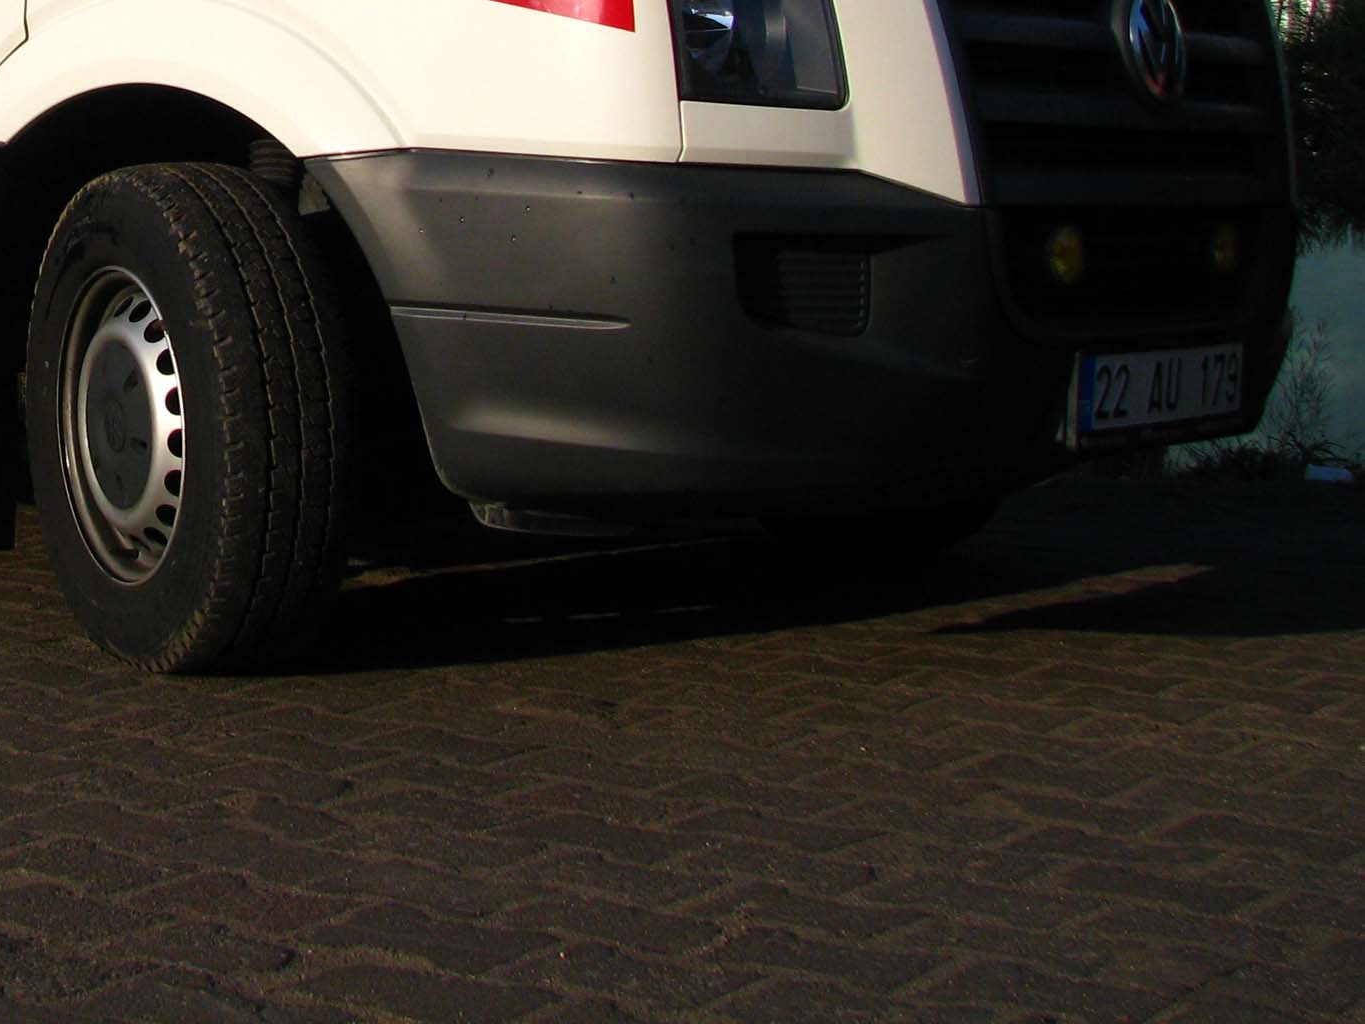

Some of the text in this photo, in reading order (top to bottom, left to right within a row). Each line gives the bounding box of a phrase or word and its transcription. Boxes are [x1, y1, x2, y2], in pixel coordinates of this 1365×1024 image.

[1095, 352, 1240, 419] 22 AU 179
